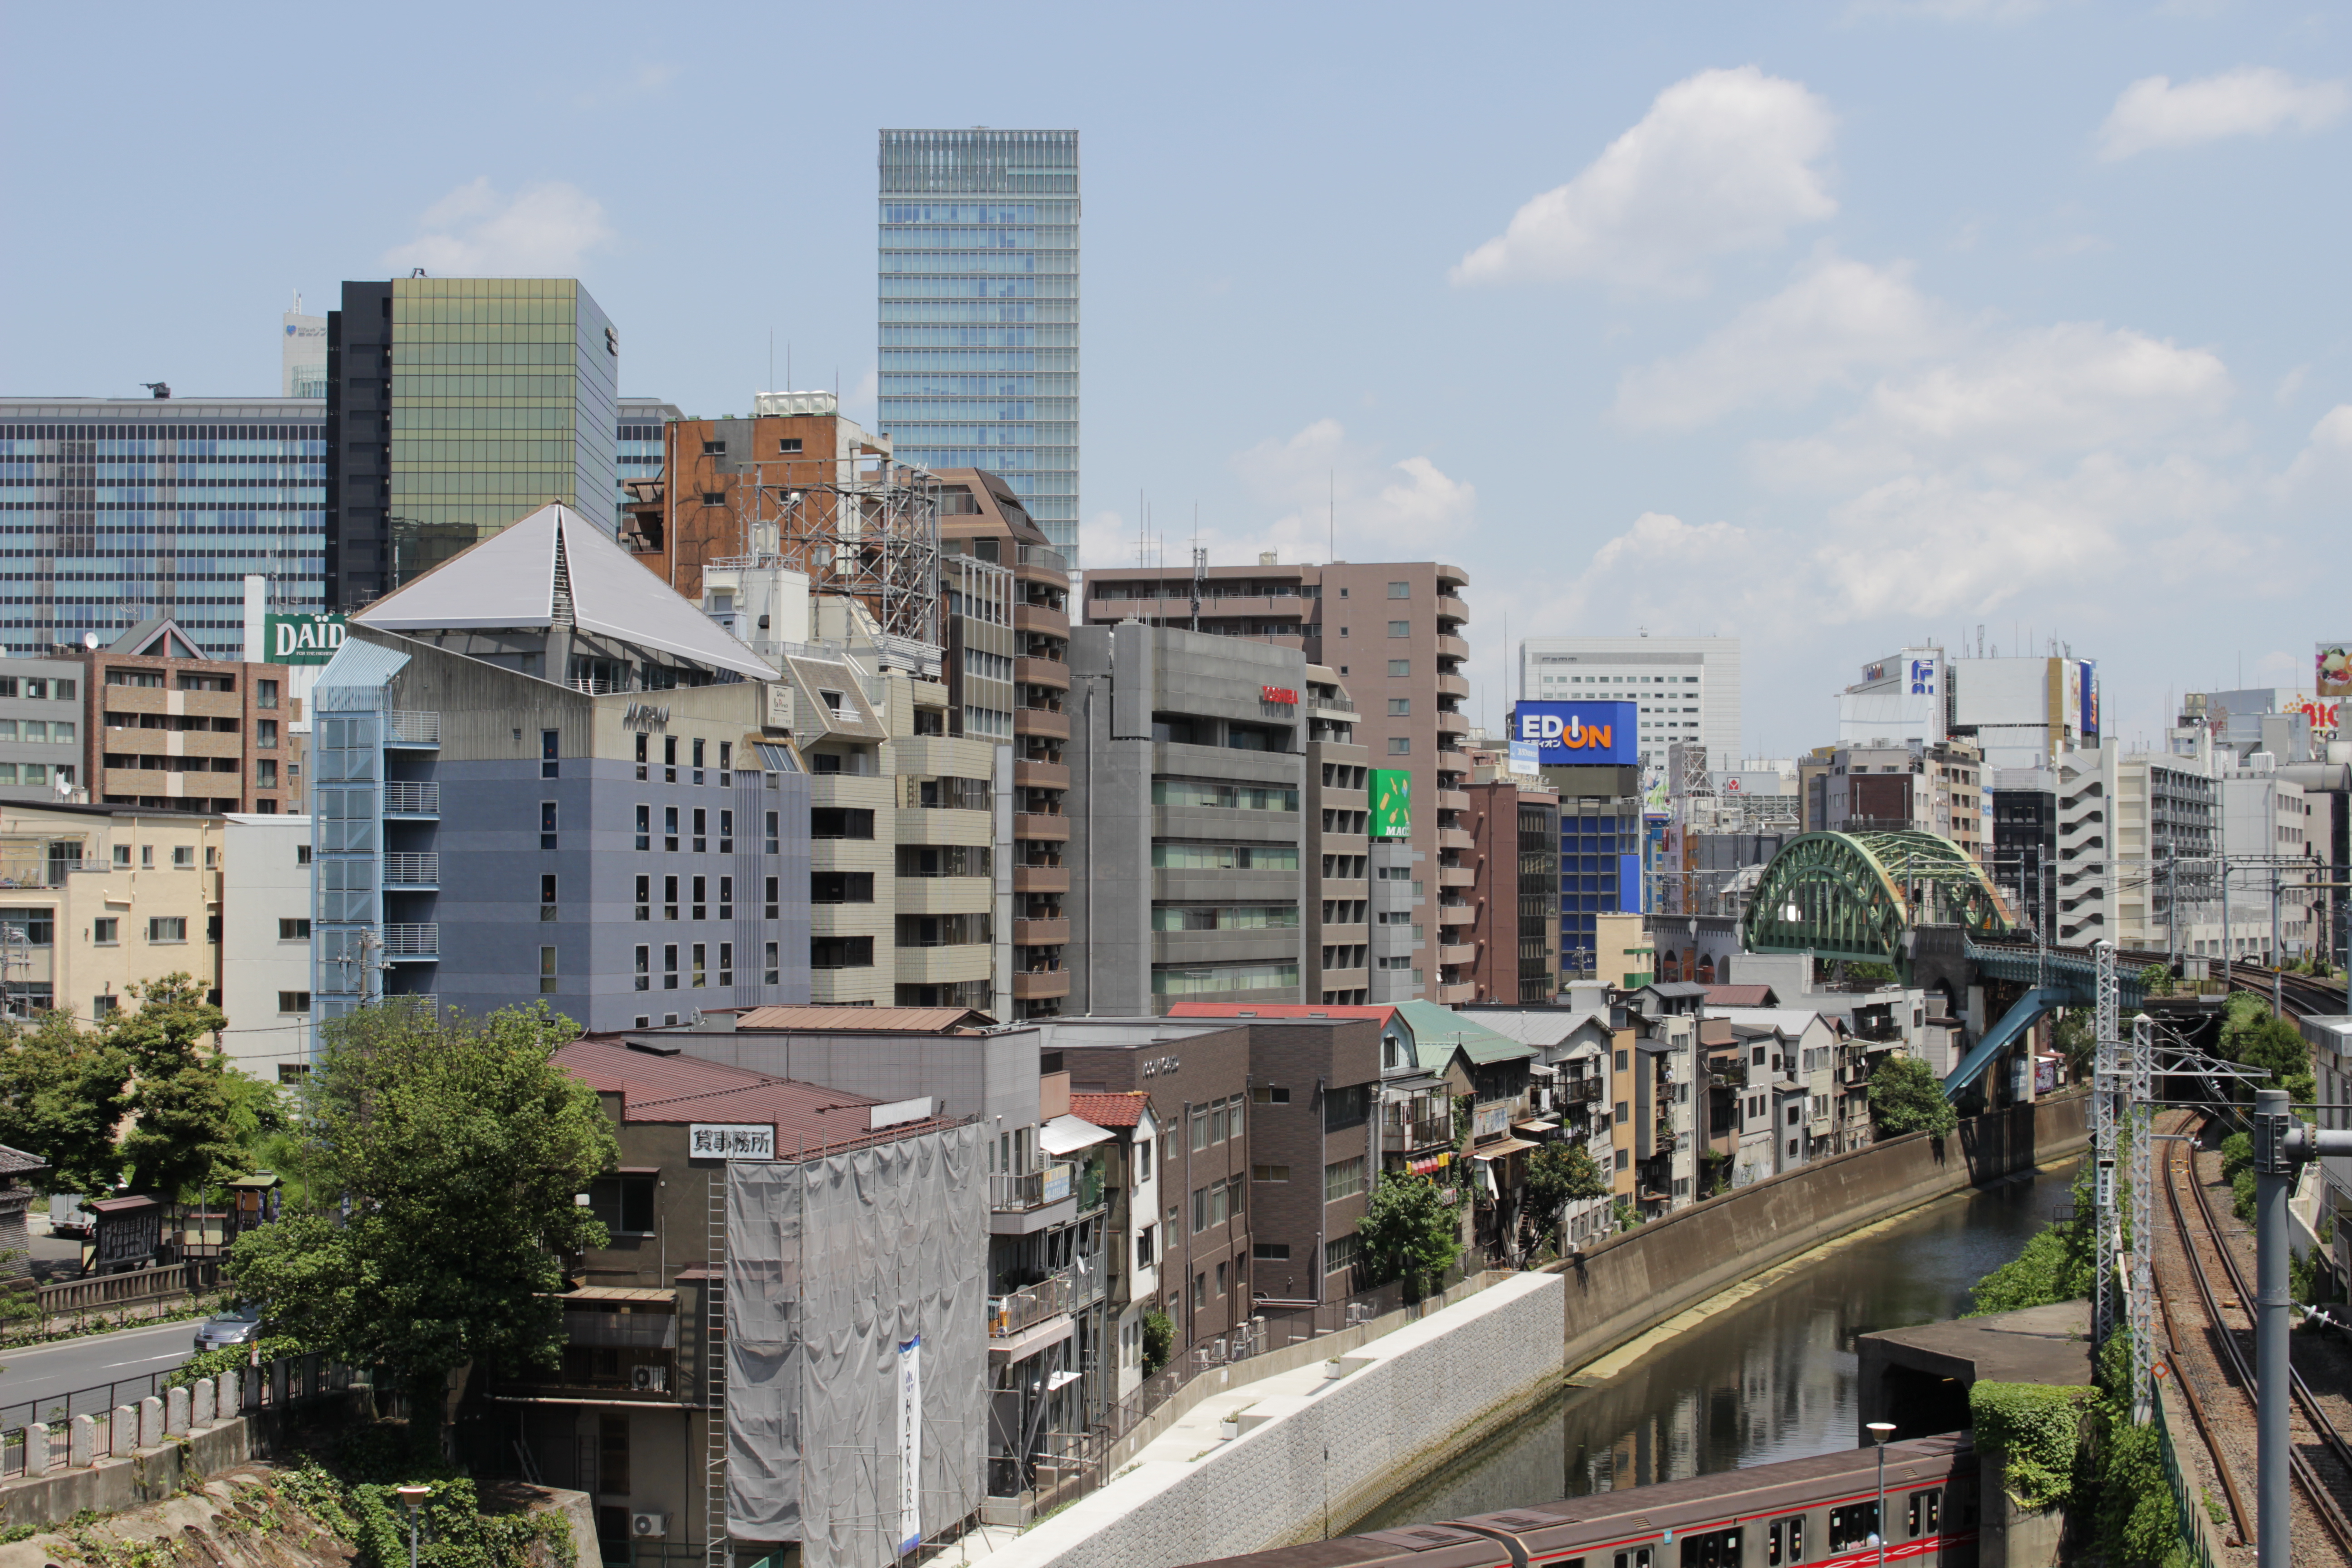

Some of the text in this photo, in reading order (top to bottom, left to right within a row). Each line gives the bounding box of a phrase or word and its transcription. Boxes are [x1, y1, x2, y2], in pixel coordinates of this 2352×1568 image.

[1263, 686, 1298, 704] TOSHIBA
[1523, 715, 1611, 748] EDION
[694, 1129, 770, 1153] 貸事務所
